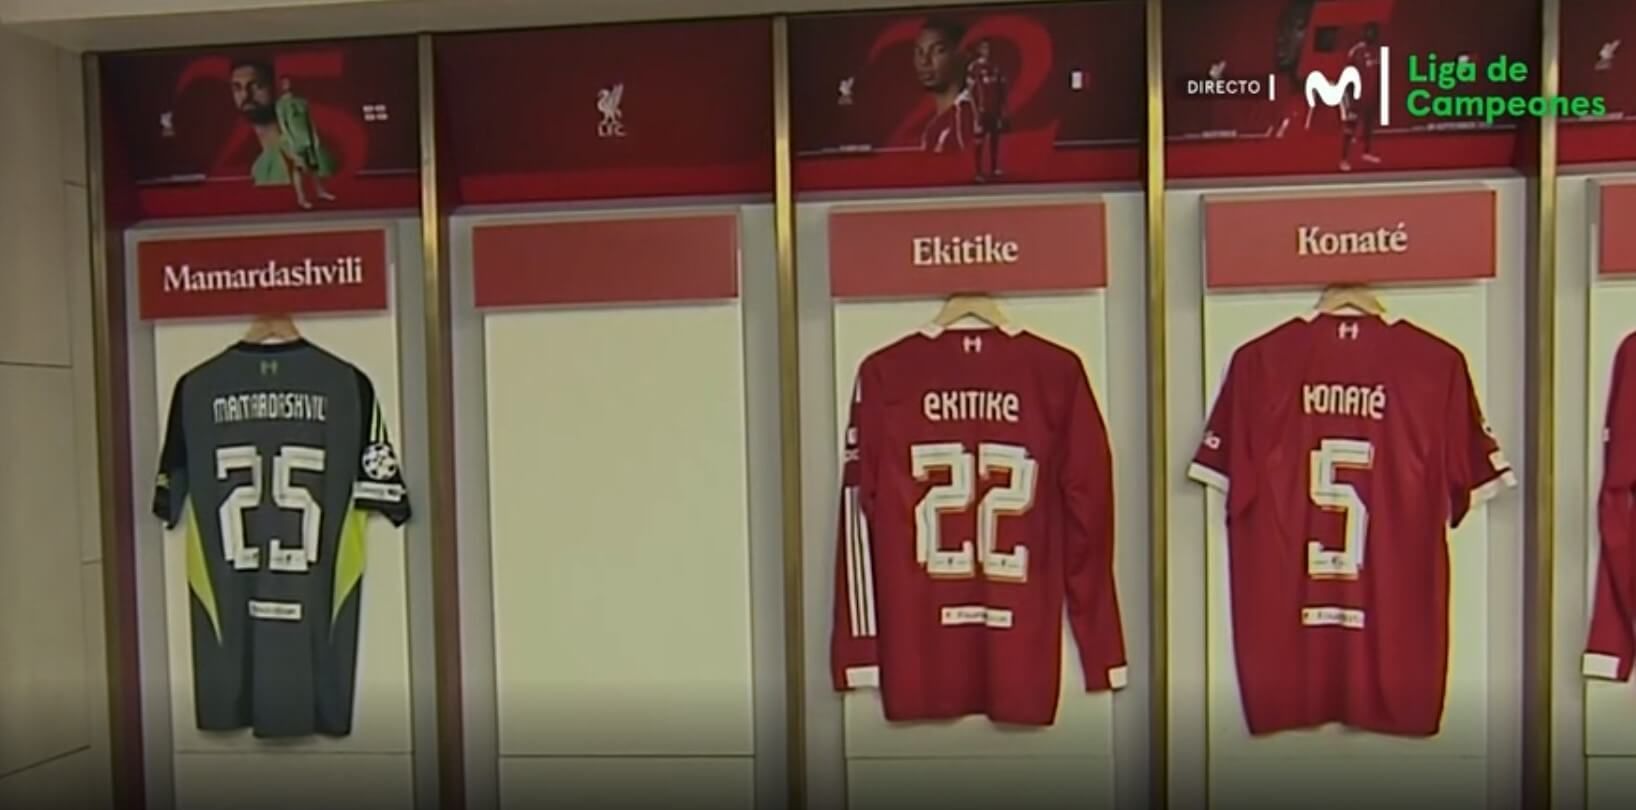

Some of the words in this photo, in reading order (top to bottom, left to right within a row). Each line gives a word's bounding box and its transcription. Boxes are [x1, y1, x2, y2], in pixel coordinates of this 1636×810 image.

[163, 256, 363, 292] Mamardashvili
[912, 234, 1019, 266] Ekitike
[1298, 222, 1408, 255] Konaté
[215, 445, 326, 571] 25
[911, 442, 1038, 582] 22
[1308, 438, 1375, 579] 5
